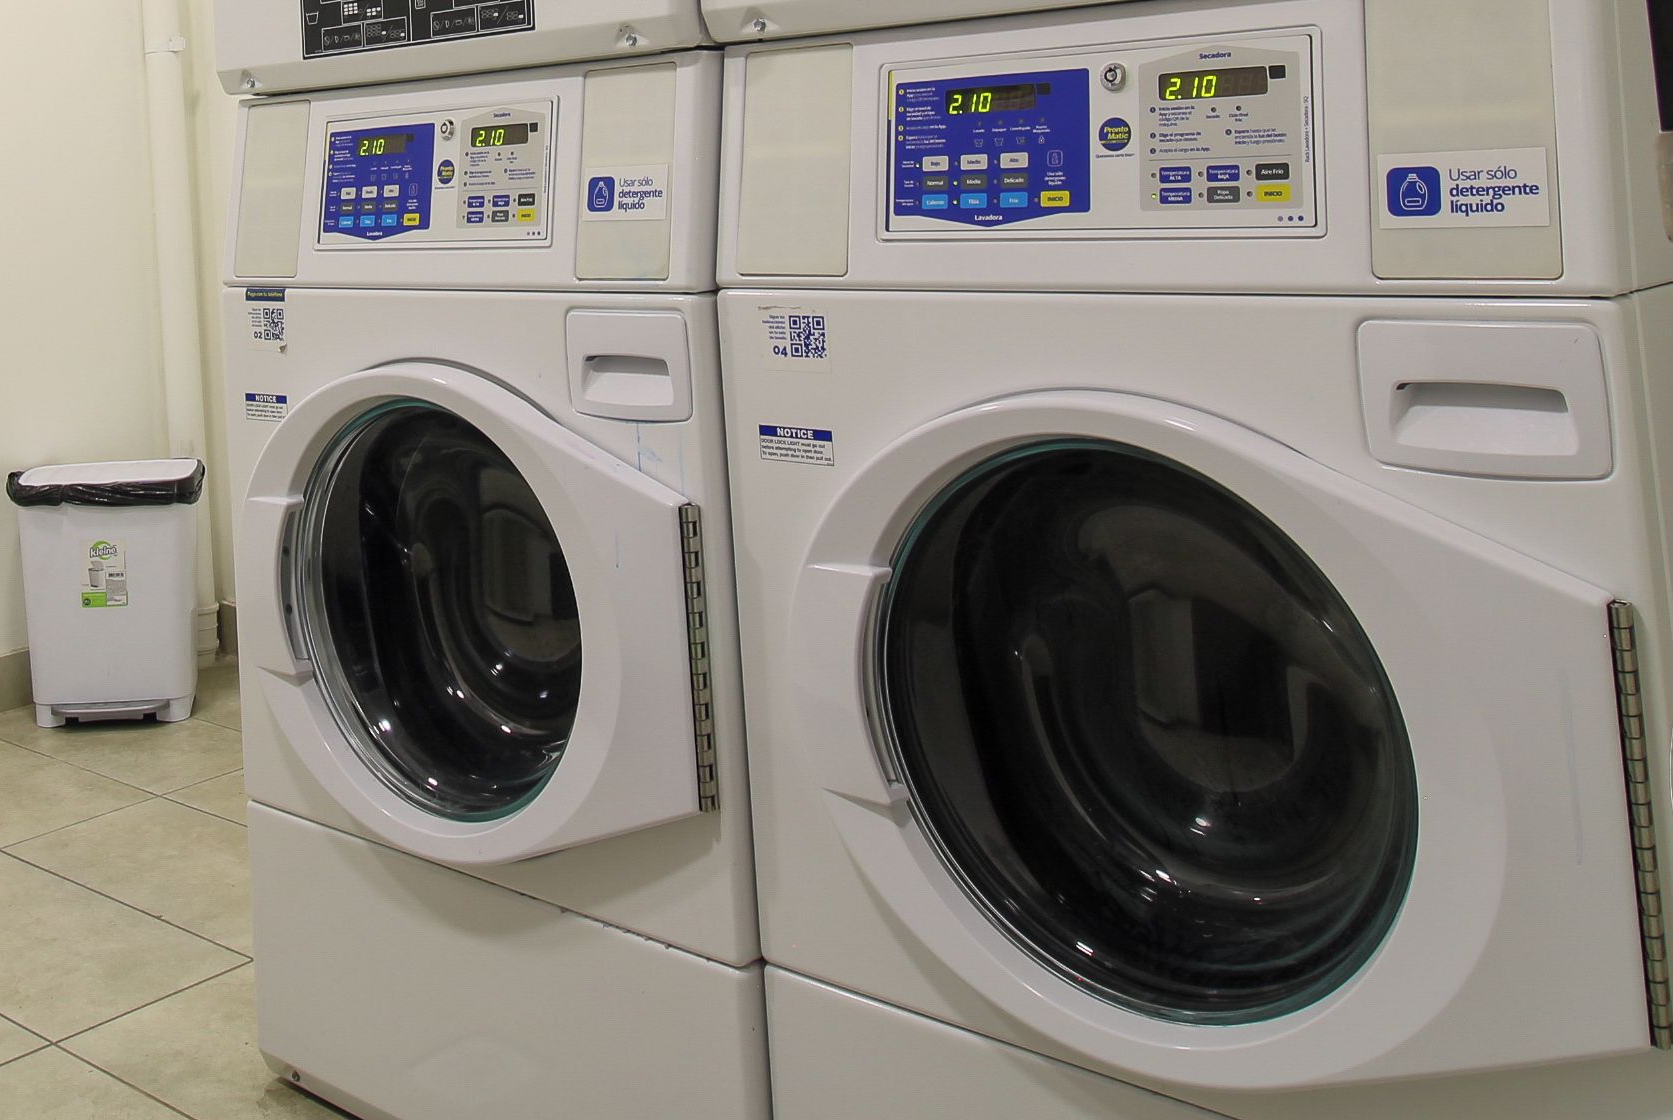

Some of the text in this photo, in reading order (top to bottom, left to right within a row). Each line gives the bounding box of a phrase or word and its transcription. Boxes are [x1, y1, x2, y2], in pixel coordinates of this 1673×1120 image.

[1199, 51, 1232, 61] Secadora
[1165, 75, 1217, 100] 2.10
[949, 92, 992, 115] 2.10
[1104, 126, 1129, 134] Pronto
[475, 129, 505, 147] 2.10
[360, 139, 385, 156] 2.10
[1208, 168, 1239, 176] Temperatura
[1448, 166, 1517, 182] Usar sólo
[619, 176, 653, 188] Usar sólo
[618, 188, 663, 201] detergente
[1449, 182, 1540, 200] detergente
[618, 200, 645, 213] líquido
[1450, 198, 1505, 217] líquido
[254, 331, 263, 340] 02
[773, 345, 788, 358] 04
[255, 394, 277, 404] NOTICE
[776, 427, 814, 440] NOTICE
